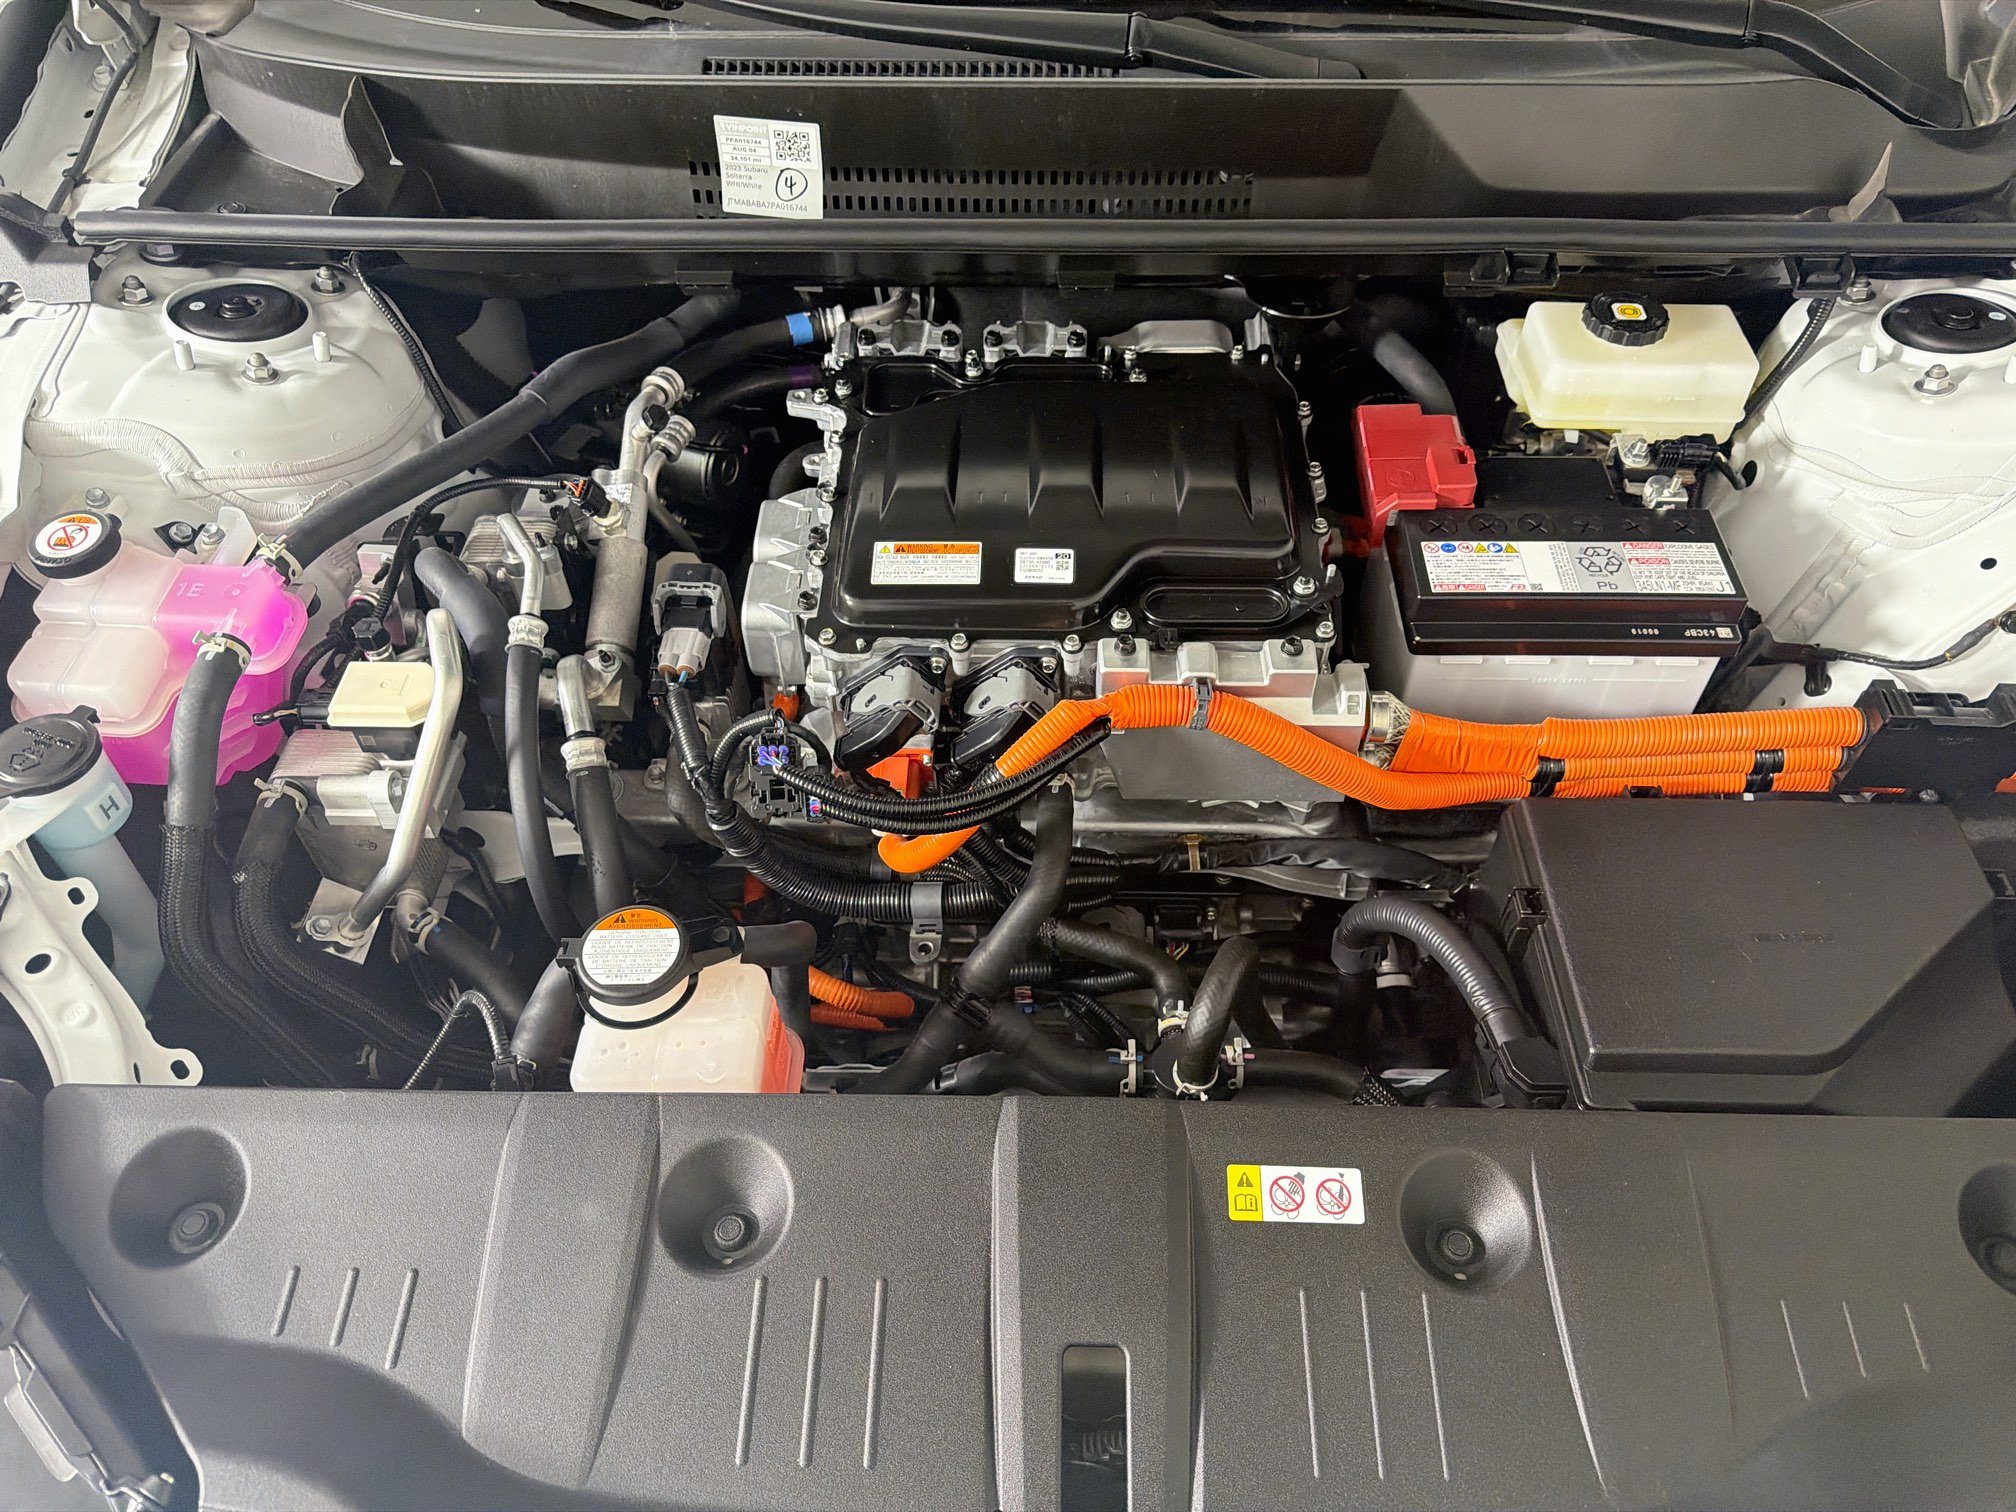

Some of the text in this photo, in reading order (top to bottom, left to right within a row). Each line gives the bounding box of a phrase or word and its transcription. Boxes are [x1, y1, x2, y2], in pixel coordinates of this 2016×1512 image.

[725, 137, 762, 146] PPA016744
[725, 164, 769, 174] 2023 Subaru
[725, 172, 753, 181] Solterra
[726, 198, 808, 213] JTMABABA7PA016744
[1596, 581, 1618, 590] Pb
[98, 795, 121, 820] H
